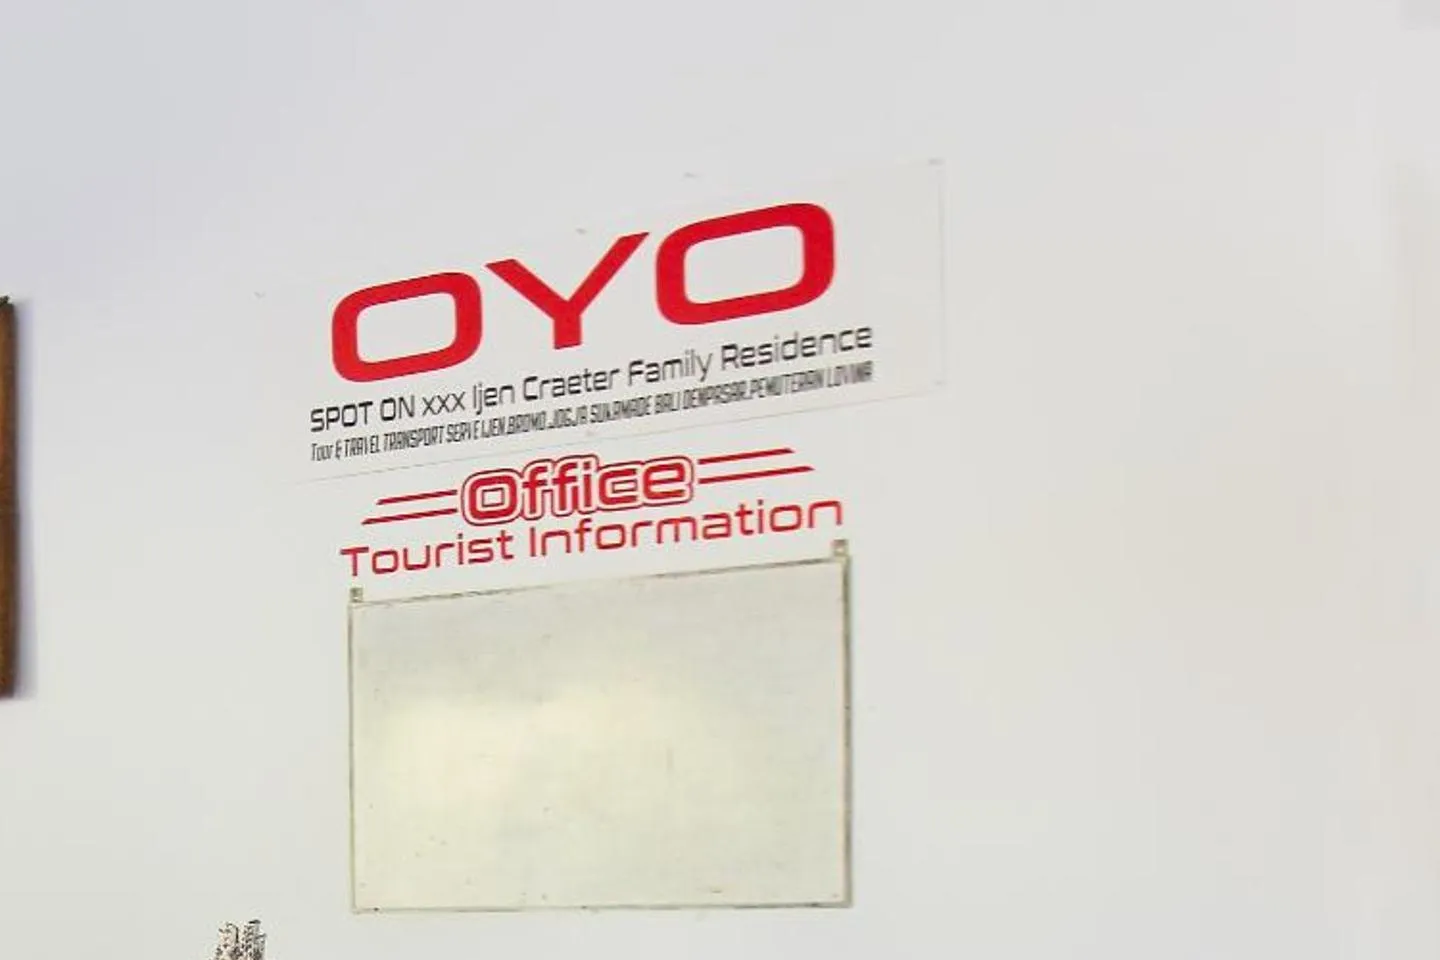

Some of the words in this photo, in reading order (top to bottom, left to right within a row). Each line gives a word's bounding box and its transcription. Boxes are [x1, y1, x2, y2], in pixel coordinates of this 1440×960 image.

[331, 202, 835, 383] OYO
[310, 401, 373, 432] SPOT
[380, 395, 415, 421] ON
[422, 391, 466, 416] xxx
[472, 383, 515, 415] Ijen
[523, 368, 620, 401] Craeter
[627, 348, 712, 386] Family
[721, 327, 872, 370] Residence
[343, 434, 380, 458] TRAVEL
[383, 425, 444, 452] TRANSPORT
[461, 453, 694, 526] Office
[340, 528, 514, 577] Tourist
[528, 499, 844, 559] Information
